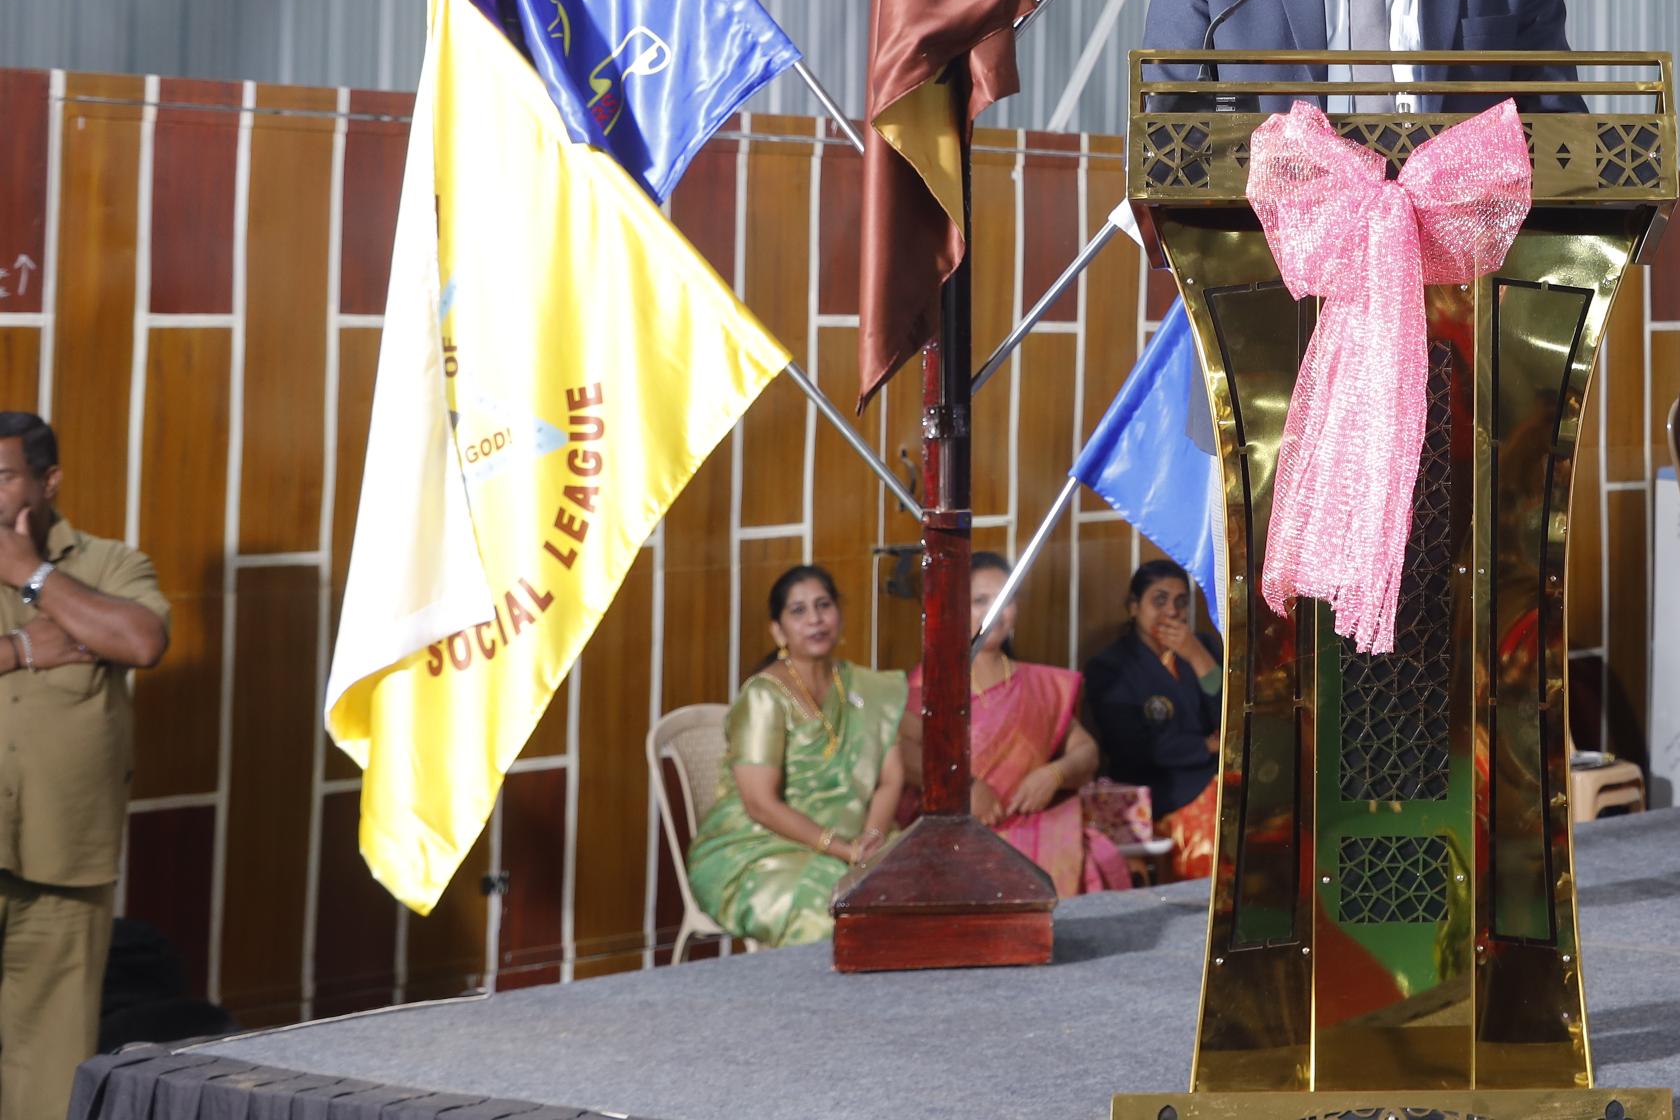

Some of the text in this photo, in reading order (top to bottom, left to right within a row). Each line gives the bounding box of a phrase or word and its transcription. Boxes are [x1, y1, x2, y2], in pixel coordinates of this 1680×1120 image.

[442, 335, 459, 379] OF
[465, 427, 513, 464] GOD!
[426, 382, 605, 677] SOCIAL LEAGUE
